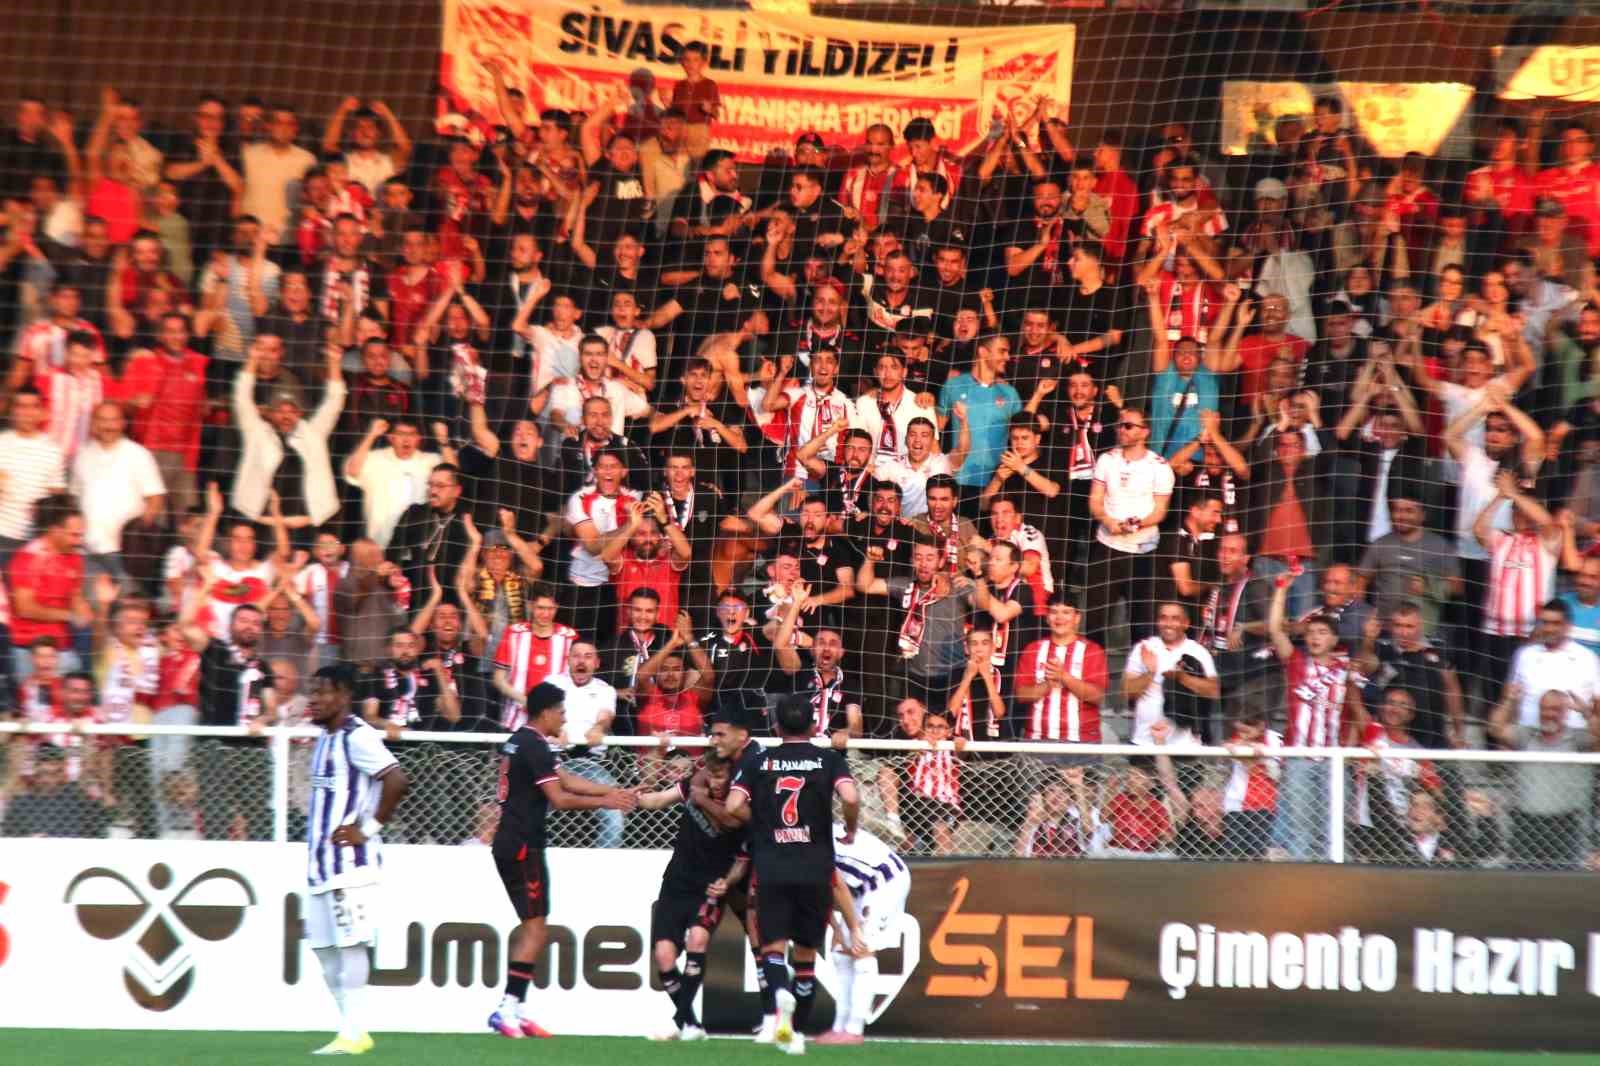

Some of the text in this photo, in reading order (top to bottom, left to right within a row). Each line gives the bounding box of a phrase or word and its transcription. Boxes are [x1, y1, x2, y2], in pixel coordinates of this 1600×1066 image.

[559, 5, 685, 66] SİVAS
[714, 95, 843, 134] YANIŞMA
[775, 776, 806, 827] 7
[1159, 922, 1398, 999] Çimento
[1413, 928, 1576, 996] Hazır
